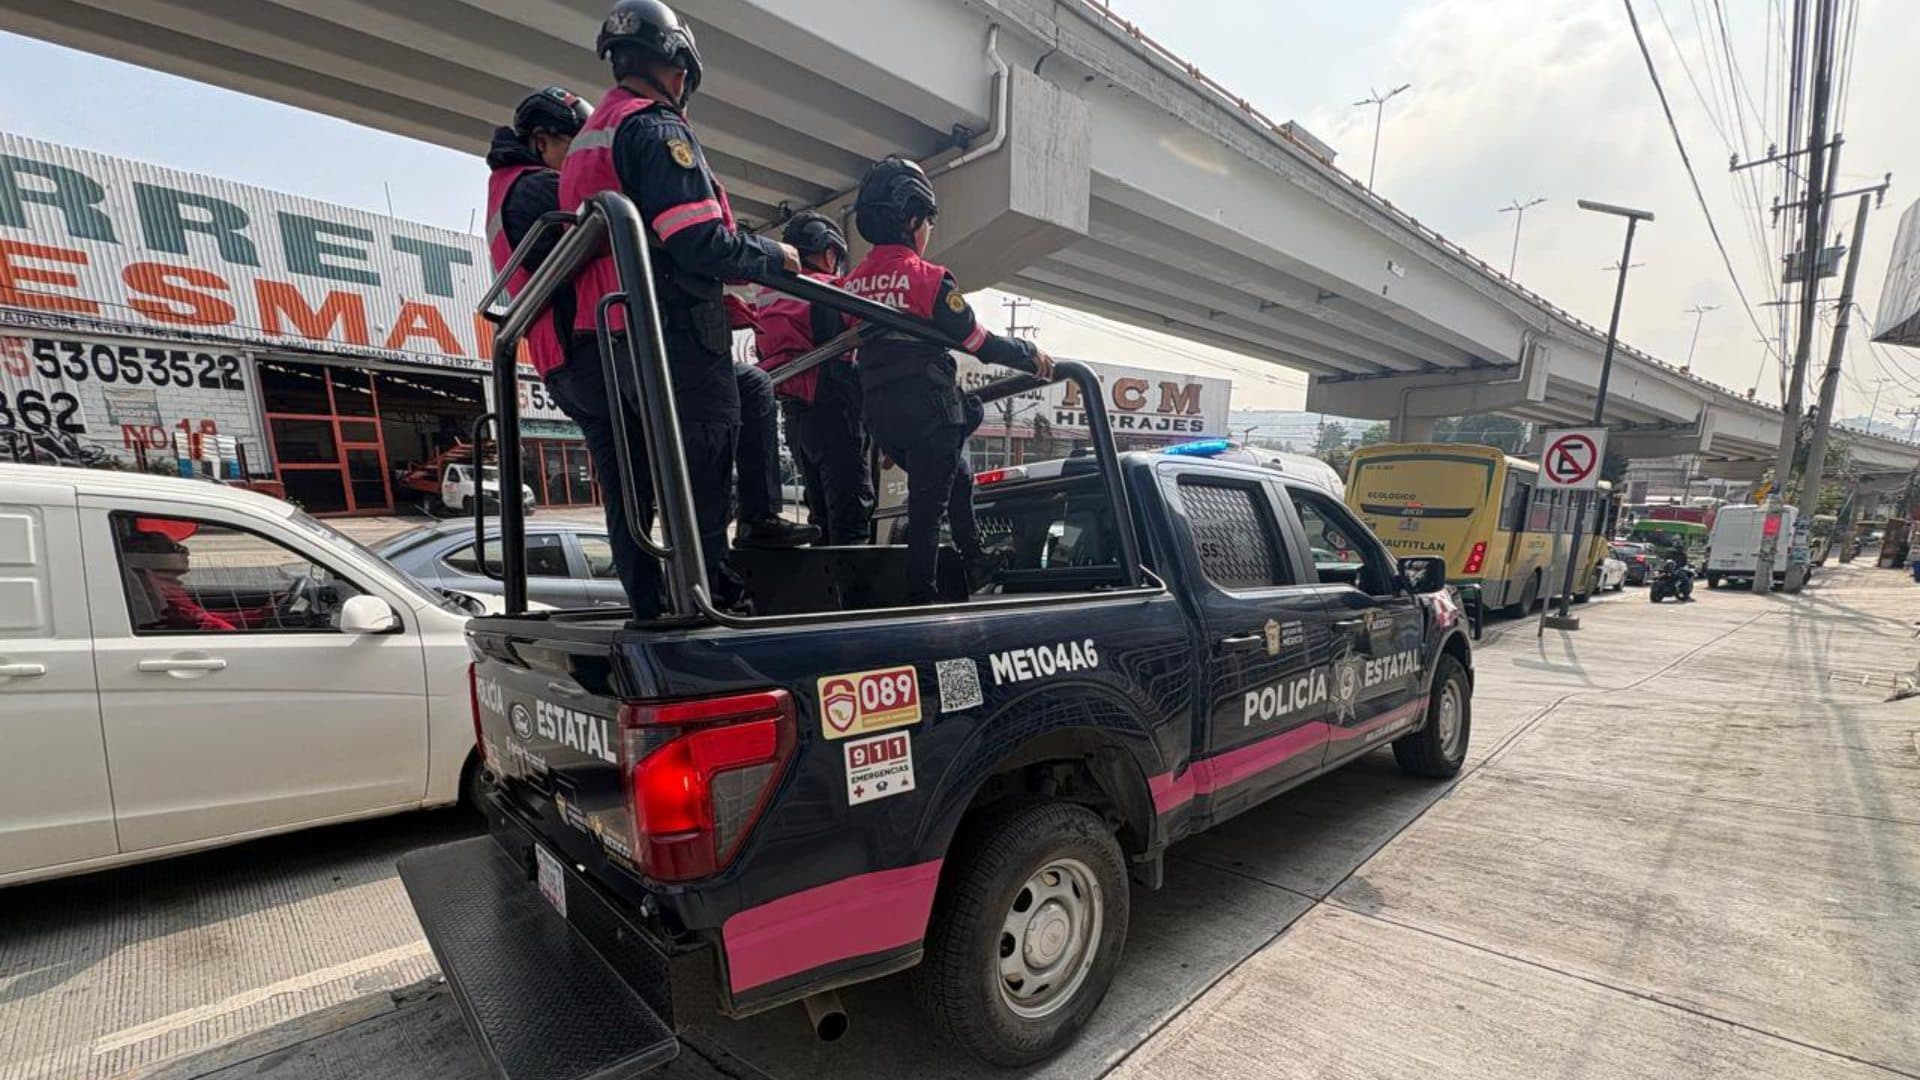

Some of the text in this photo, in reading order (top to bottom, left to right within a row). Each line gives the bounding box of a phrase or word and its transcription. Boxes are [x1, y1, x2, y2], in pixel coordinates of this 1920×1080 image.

[0, 154, 510, 307] RRET
[843, 270, 910, 293] POLICÍA
[32, 338, 245, 390] 53053522
[1056, 411, 1204, 432] HERAJES
[989, 638, 1099, 685] ME104A6
[861, 673, 912, 710] 089
[1243, 648, 1422, 727] POLICÍA ESTATAL
[536, 699, 618, 765] ESTATAL
[853, 739, 902, 766] 911
[850, 763, 910, 784] EMERGENCIAS
